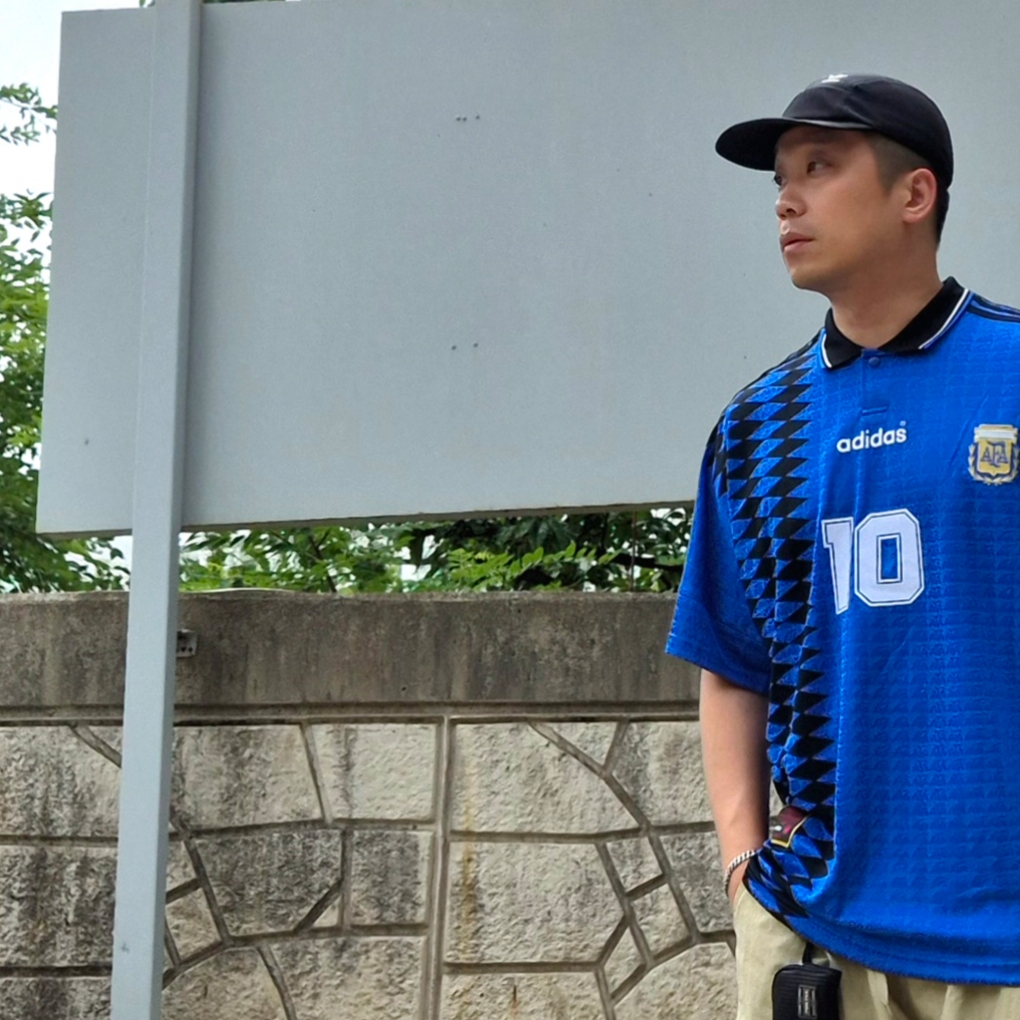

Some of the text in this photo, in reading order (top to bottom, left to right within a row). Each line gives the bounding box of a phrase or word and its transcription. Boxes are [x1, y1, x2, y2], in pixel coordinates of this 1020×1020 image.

[836, 427, 907, 453] adidas
[980, 440, 1009, 468] AFA
[821, 508, 925, 615] 10
